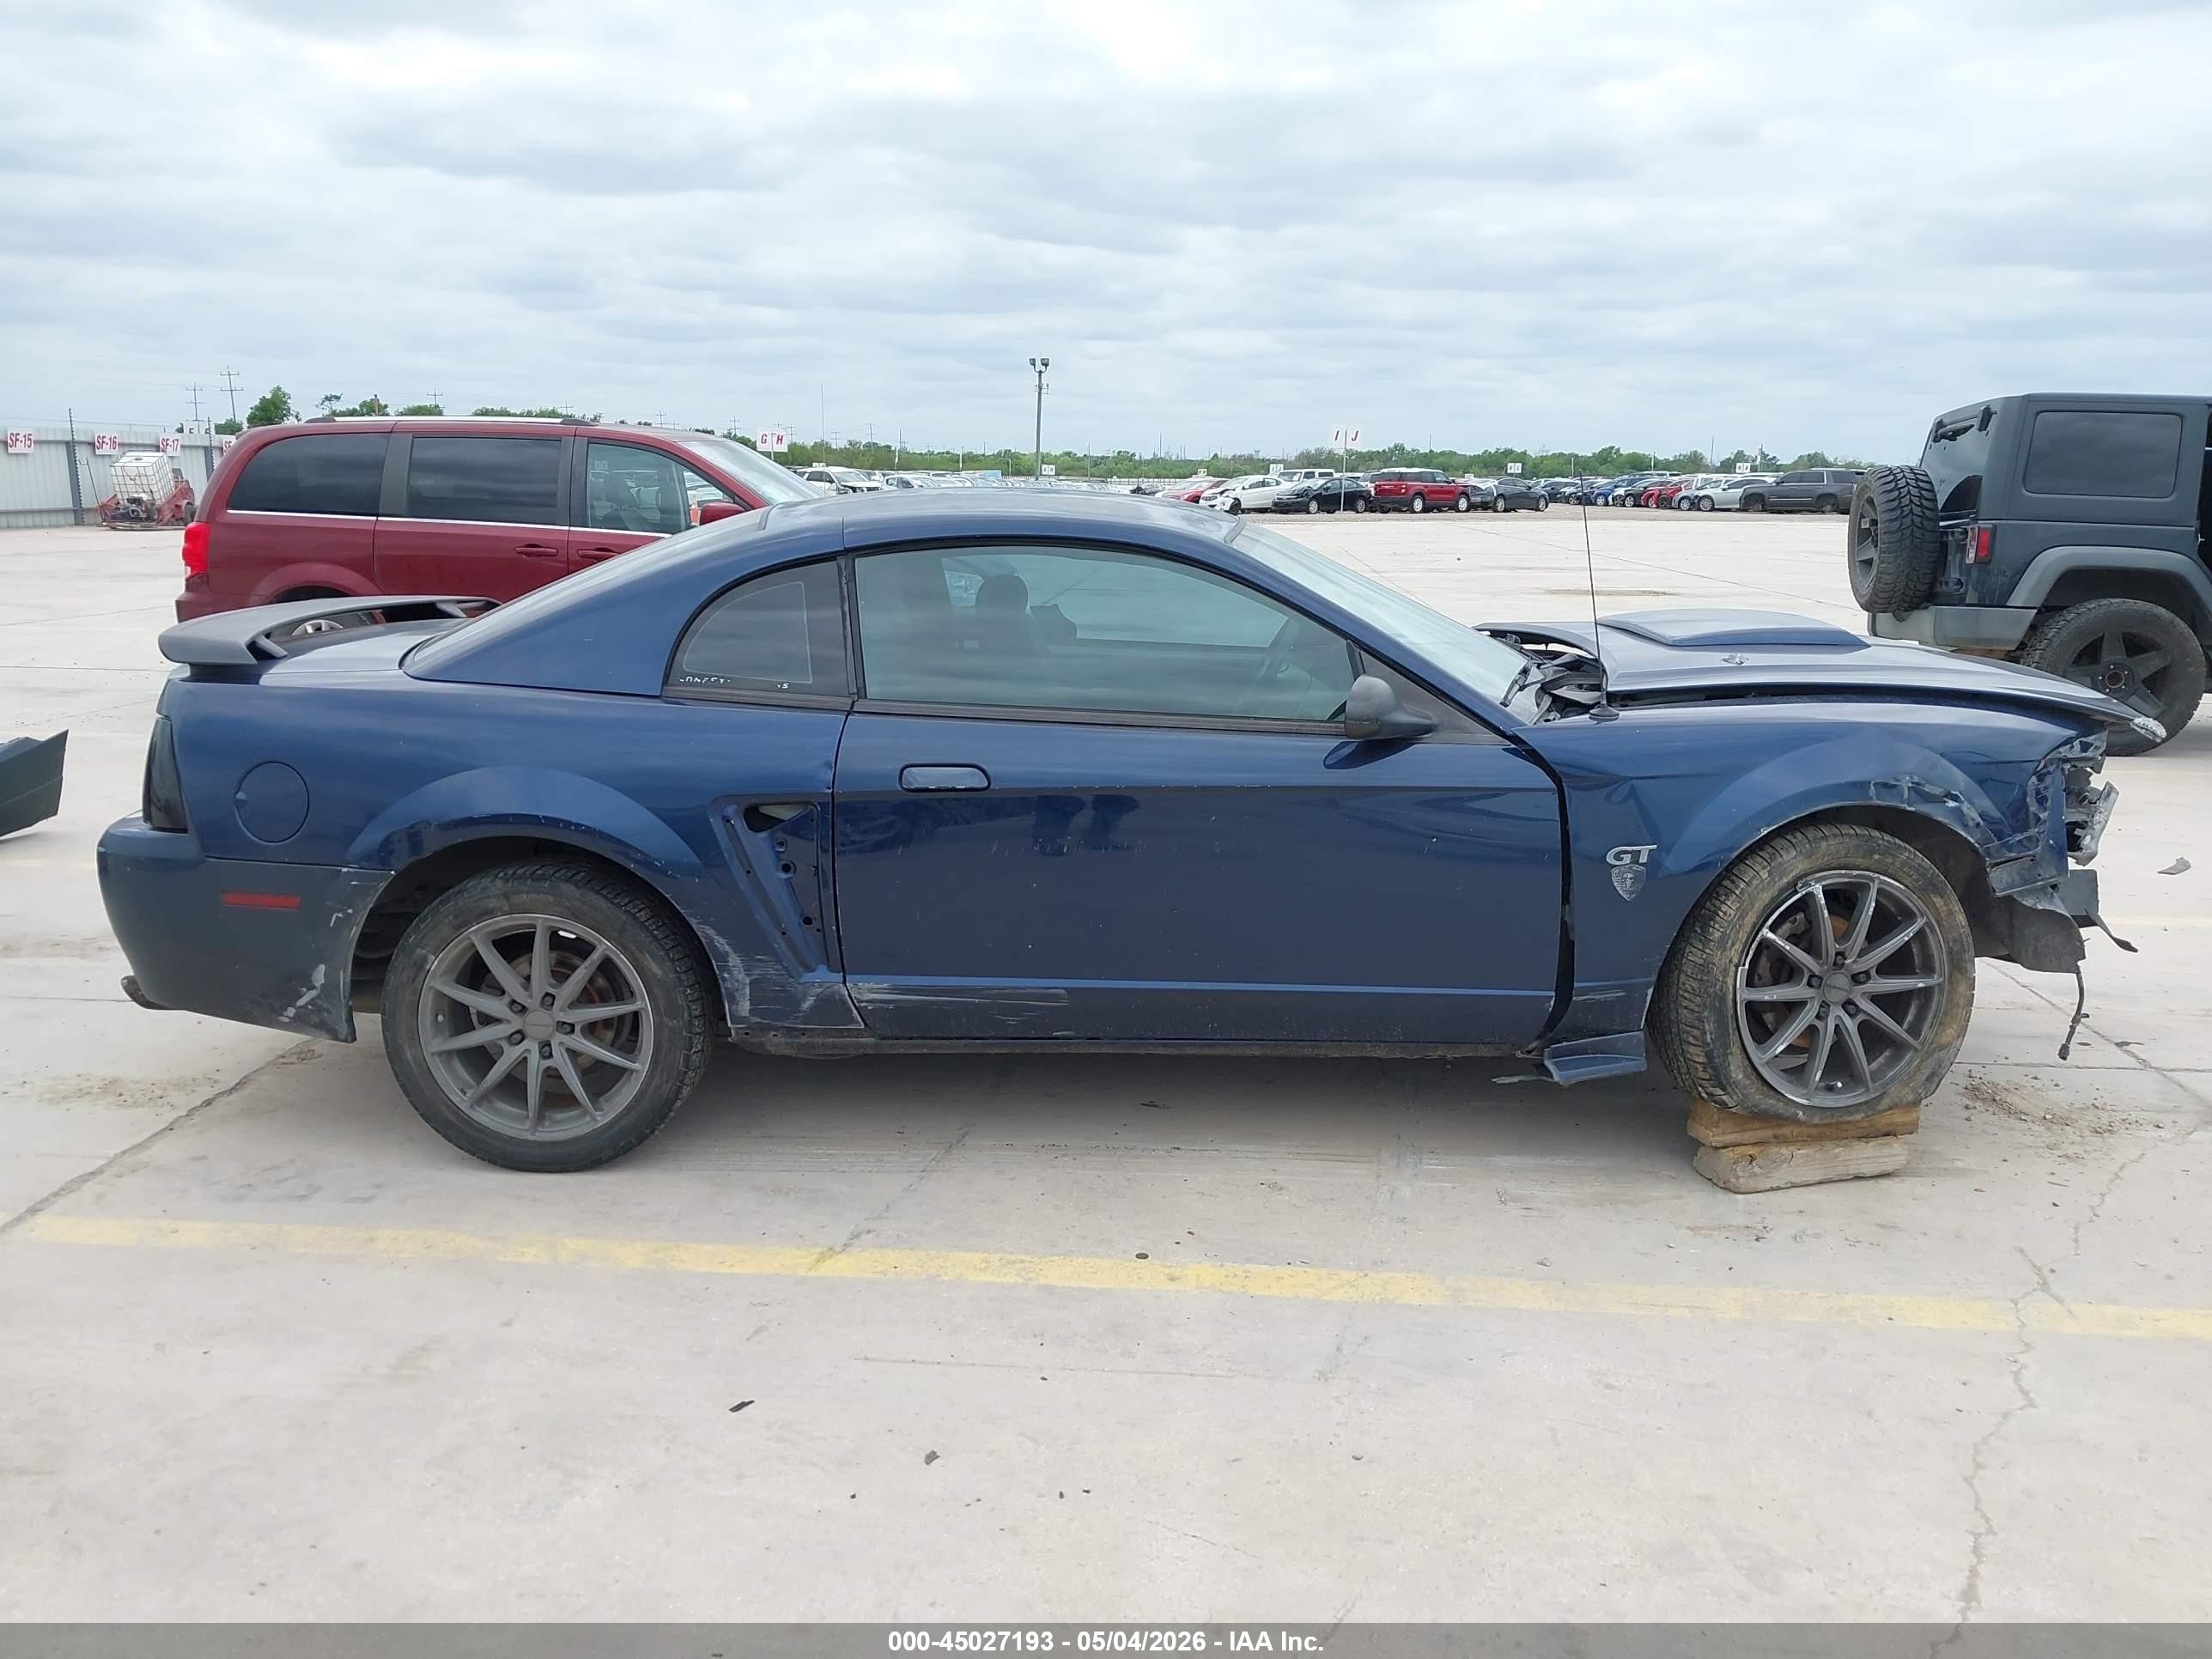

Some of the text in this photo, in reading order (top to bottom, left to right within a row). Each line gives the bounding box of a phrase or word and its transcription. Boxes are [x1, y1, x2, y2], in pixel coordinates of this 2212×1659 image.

[9, 432, 33, 448] SF-15
[95, 434, 118, 451] SF-16
[761, 434, 784, 445] G H
[1352, 430, 1359, 441] J
[161, 437, 179, 453] SF-17
[1606, 844, 1658, 866] GT
